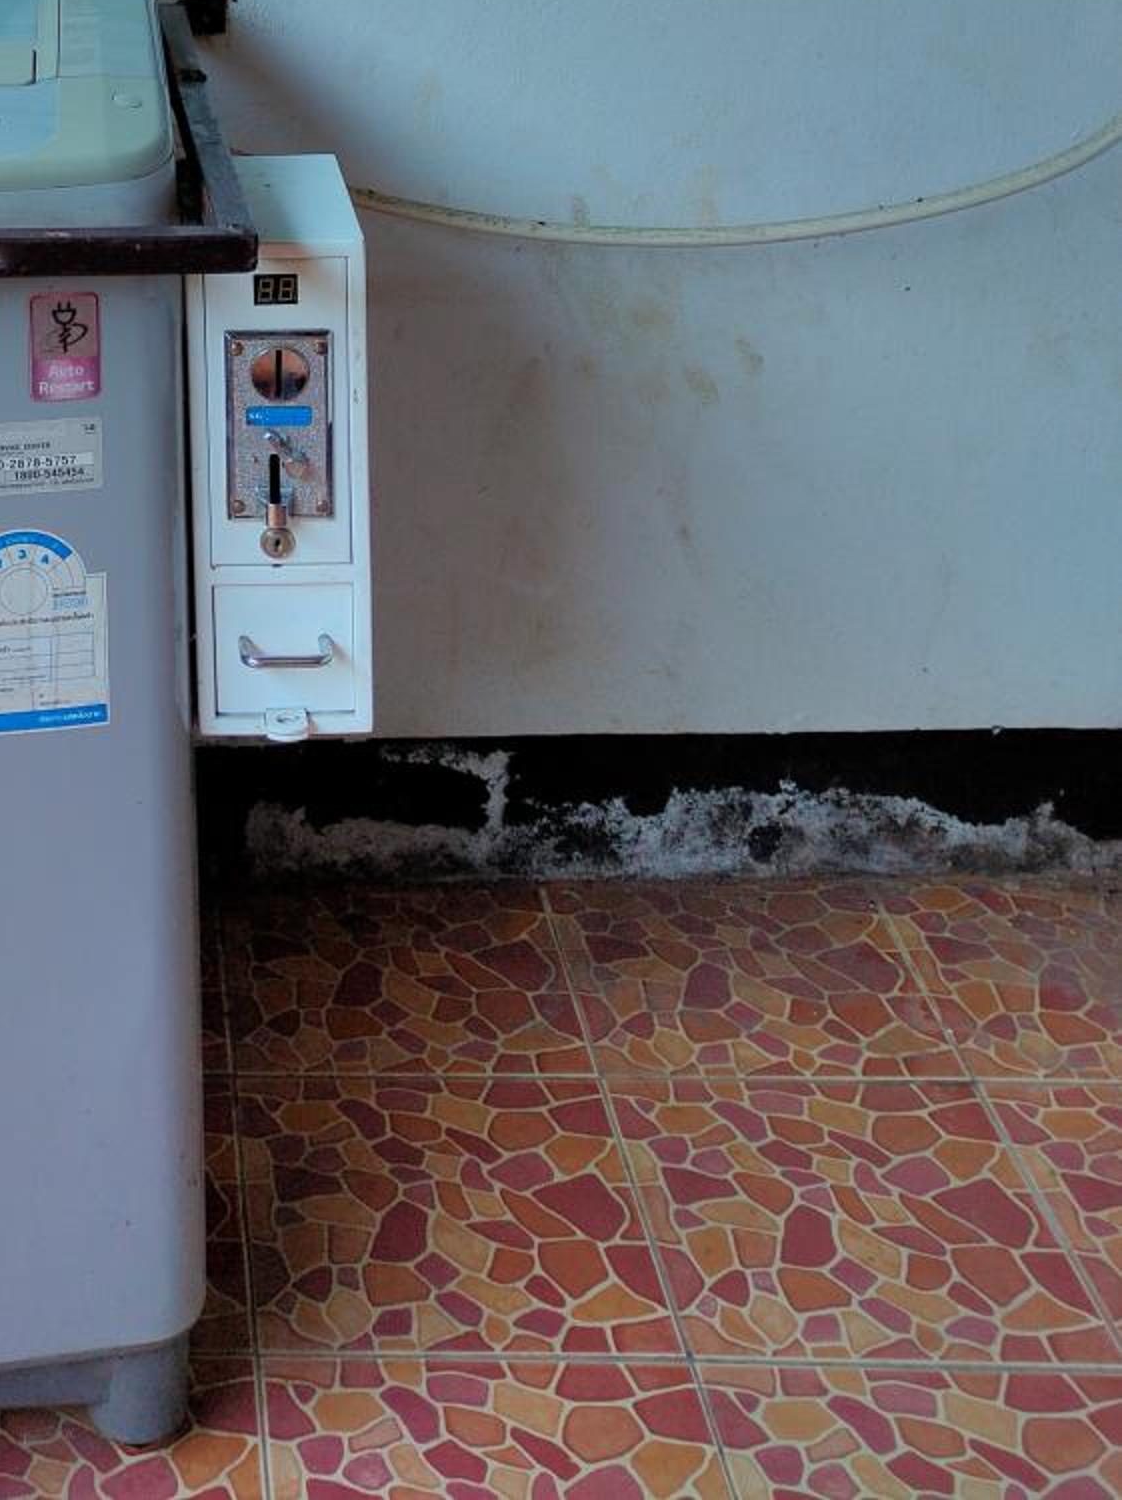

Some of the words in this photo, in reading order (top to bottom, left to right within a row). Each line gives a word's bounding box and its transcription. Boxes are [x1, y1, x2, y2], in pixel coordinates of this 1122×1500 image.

[48, 364, 84, 378] Auto
[17, 549, 28, 560] 3
[40, 554, 50, 565] 4
